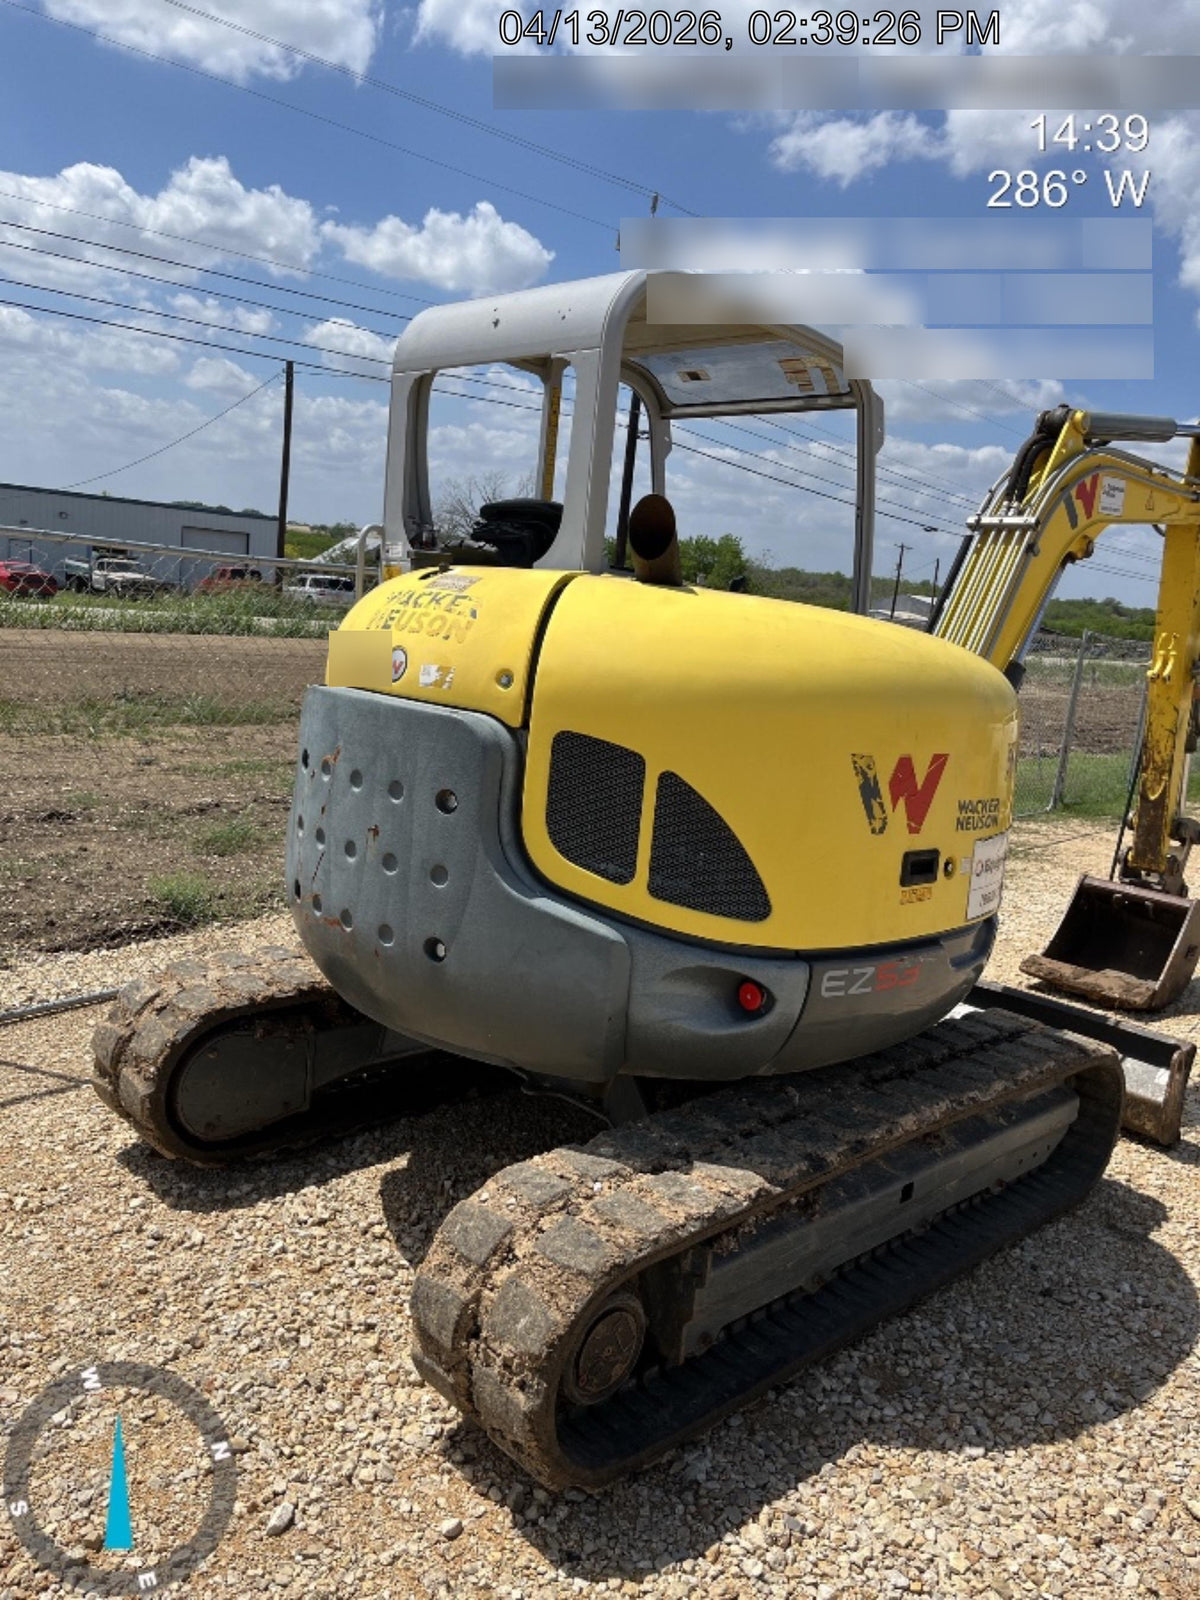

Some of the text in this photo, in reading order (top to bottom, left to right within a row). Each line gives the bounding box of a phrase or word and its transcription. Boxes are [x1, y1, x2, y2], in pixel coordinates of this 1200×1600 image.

[386, 589, 481, 618] WACKE
[957, 797, 1000, 815] WACKER
[955, 814, 999, 833] NEUSON
